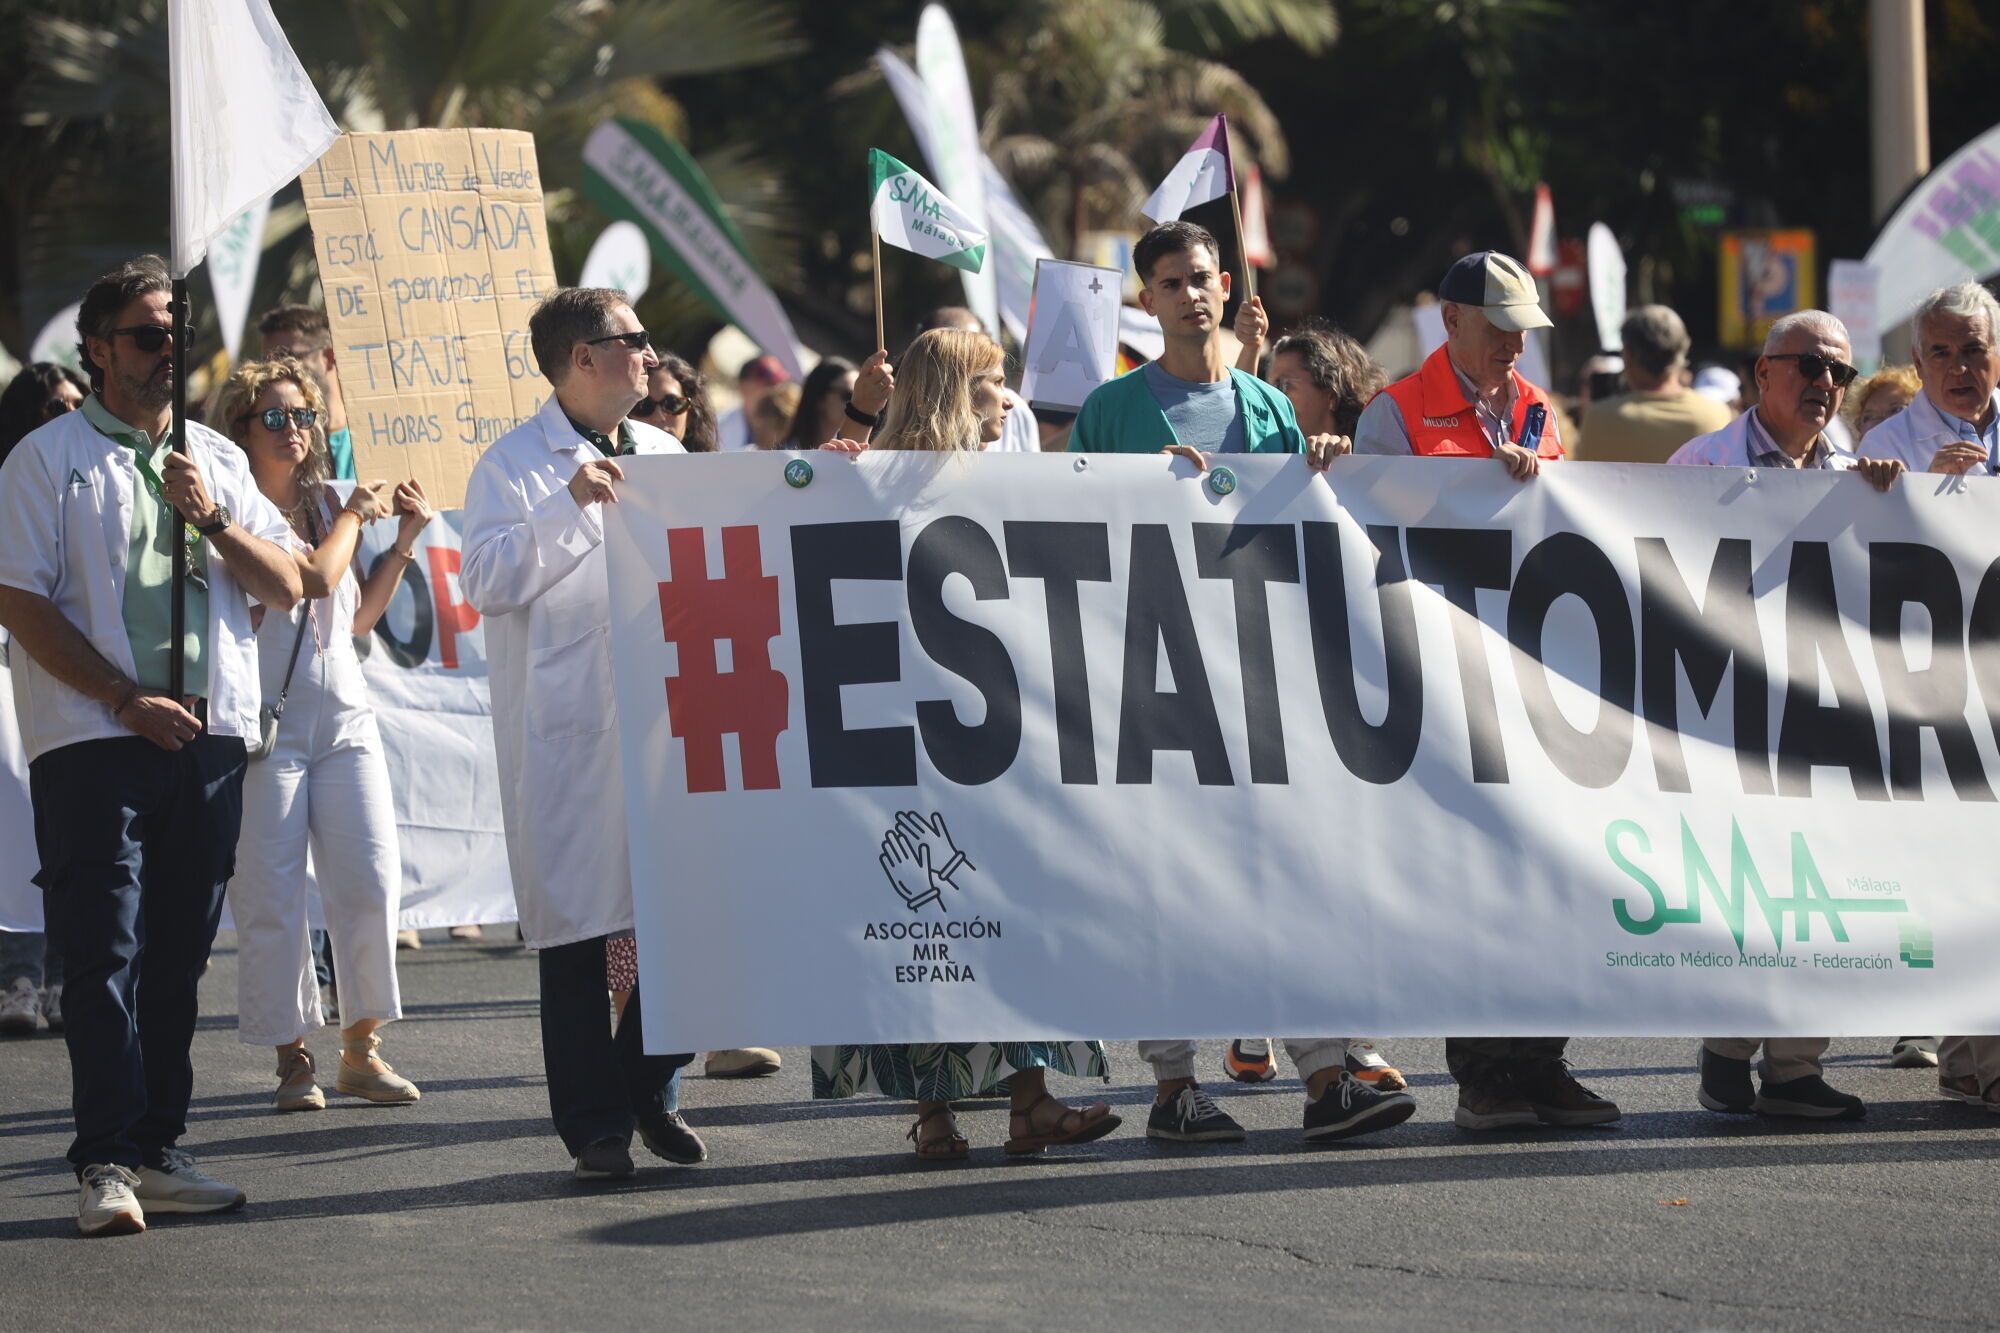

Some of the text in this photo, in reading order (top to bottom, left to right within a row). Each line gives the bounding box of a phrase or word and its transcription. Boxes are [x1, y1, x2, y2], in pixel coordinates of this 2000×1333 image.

[316, 139, 535, 199] LA MUJER de Verde
[890, 176, 951, 221] SMA
[400, 204, 537, 253] CANSADA
[336, 269, 546, 338] DE ponerse EL
[349, 335, 473, 391] TRAJE
[369, 411, 442, 446] HORAS
[1605, 811, 1909, 954] SMA
[1846, 877, 1901, 895] Málaga
[864, 915, 1002, 940] ASOCIACIÓN
[895, 961, 976, 983] ESPAÑA
[912, 943, 949, 961] MIR
[1606, 952, 1675, 967] Sindicato
[1680, 951, 1733, 967] Médico
[1738, 952, 1797, 968] Andaluz
[1813, 953, 1893, 969] Federación
